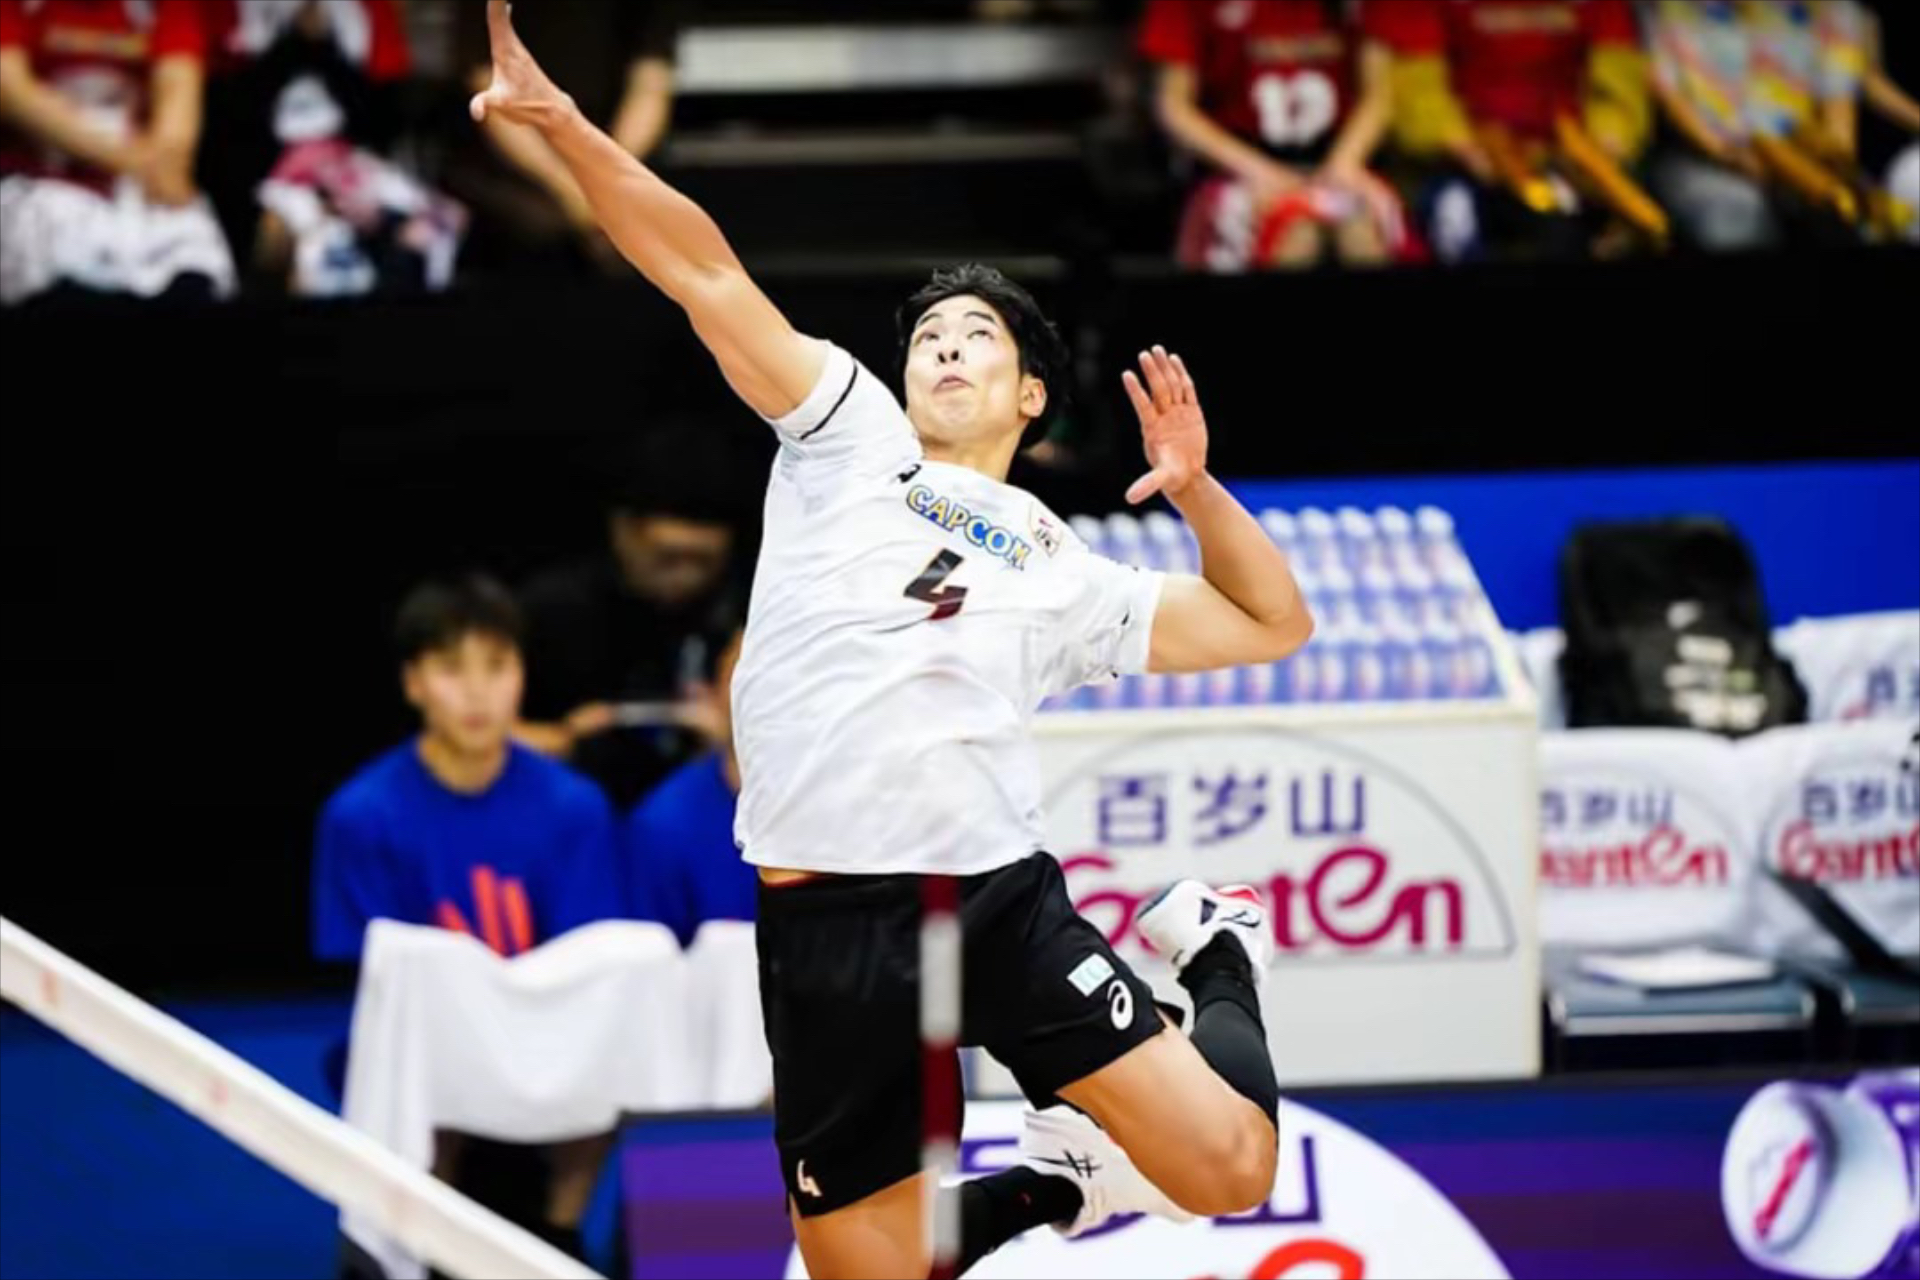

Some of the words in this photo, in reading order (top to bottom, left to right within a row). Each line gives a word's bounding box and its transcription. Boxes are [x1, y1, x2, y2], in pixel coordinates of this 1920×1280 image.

[906, 485, 1031, 570] CAPCOM
[903, 548, 968, 620] 4
[1097, 772, 1366, 846] 百岁山
[1779, 820, 1920, 881] Gant
[1063, 845, 1464, 953] Gten
